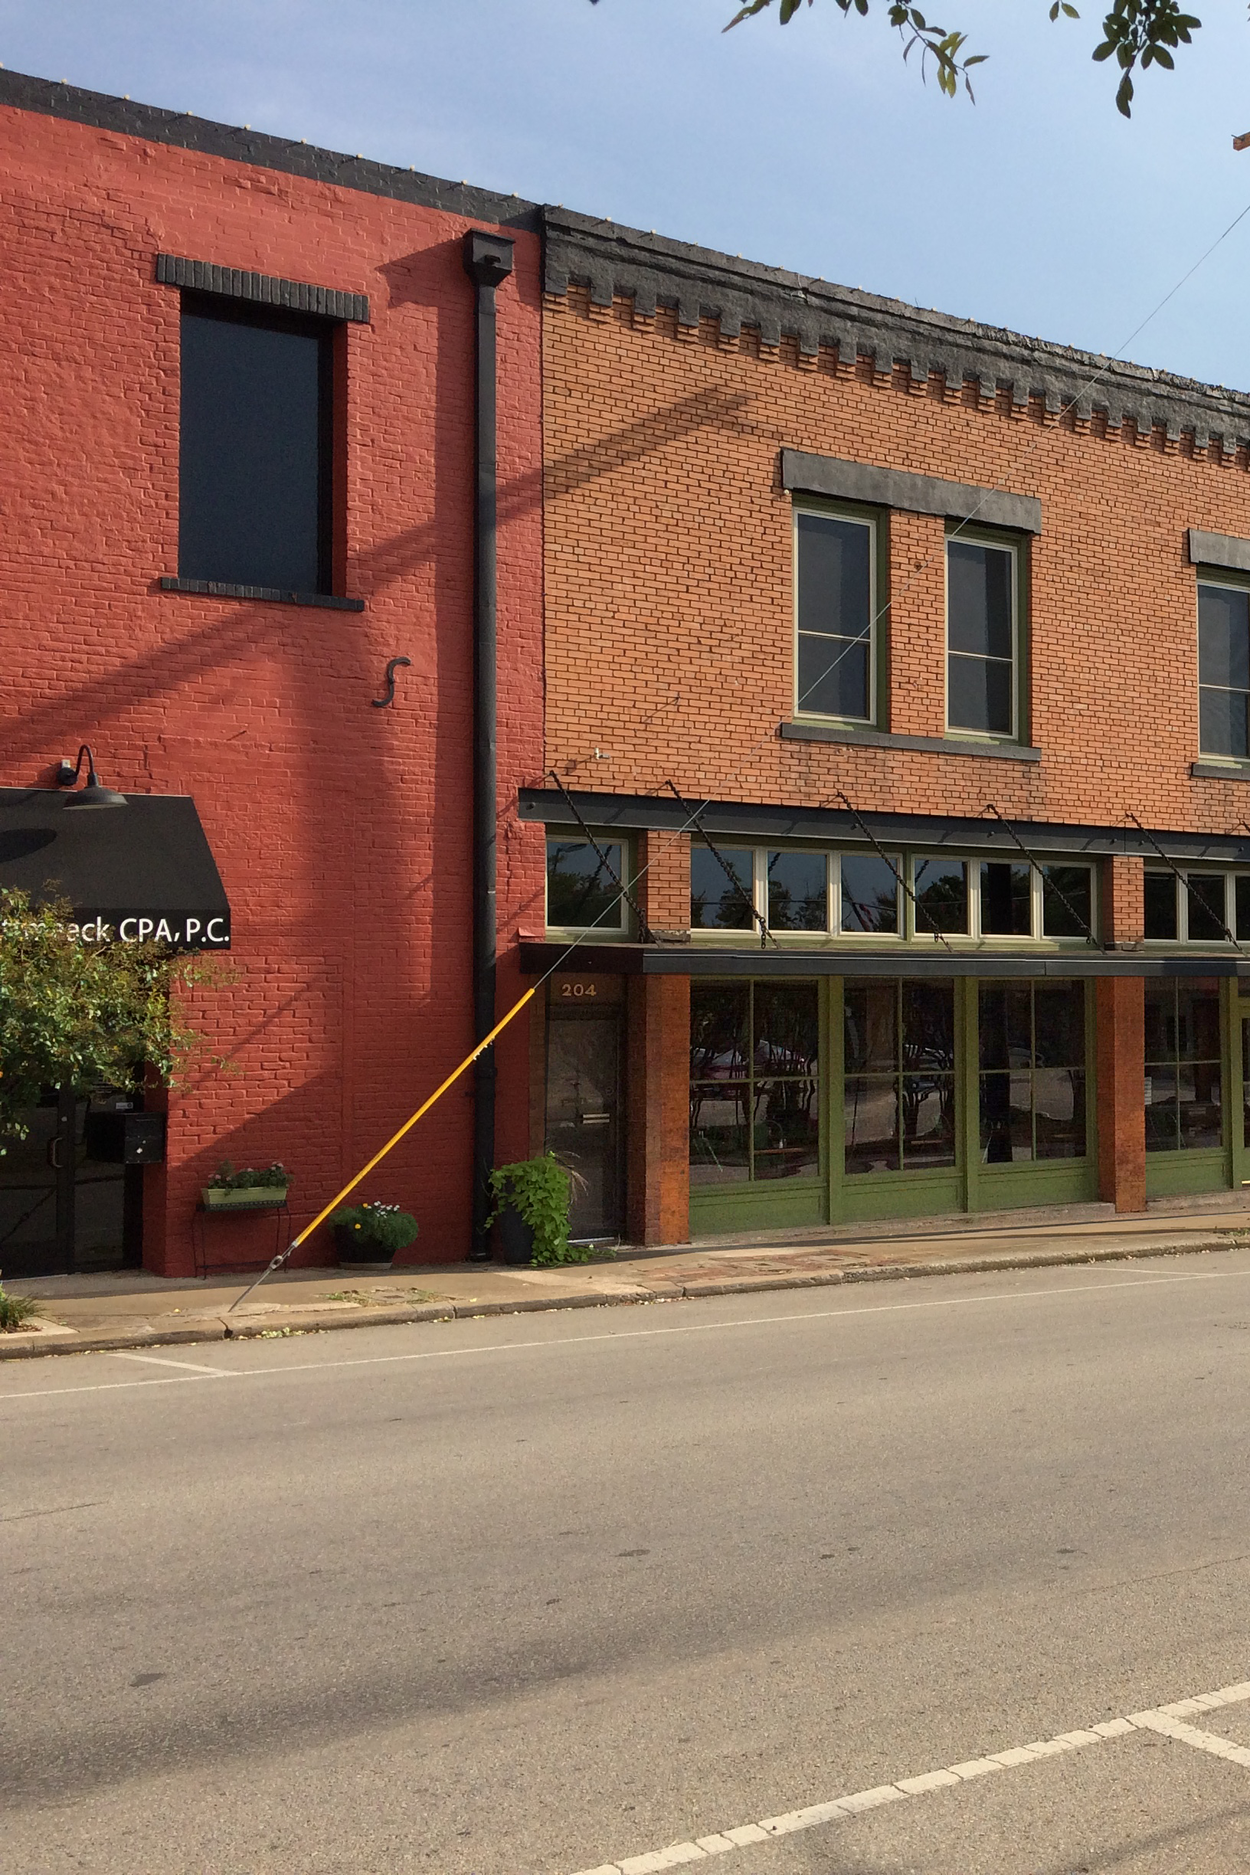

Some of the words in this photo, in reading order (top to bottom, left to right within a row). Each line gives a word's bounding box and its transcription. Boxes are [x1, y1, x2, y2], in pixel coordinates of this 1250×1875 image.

[119, 917, 181, 943] CPA,
[186, 917, 230, 943] P.C.
[561, 983, 597, 997] 204
